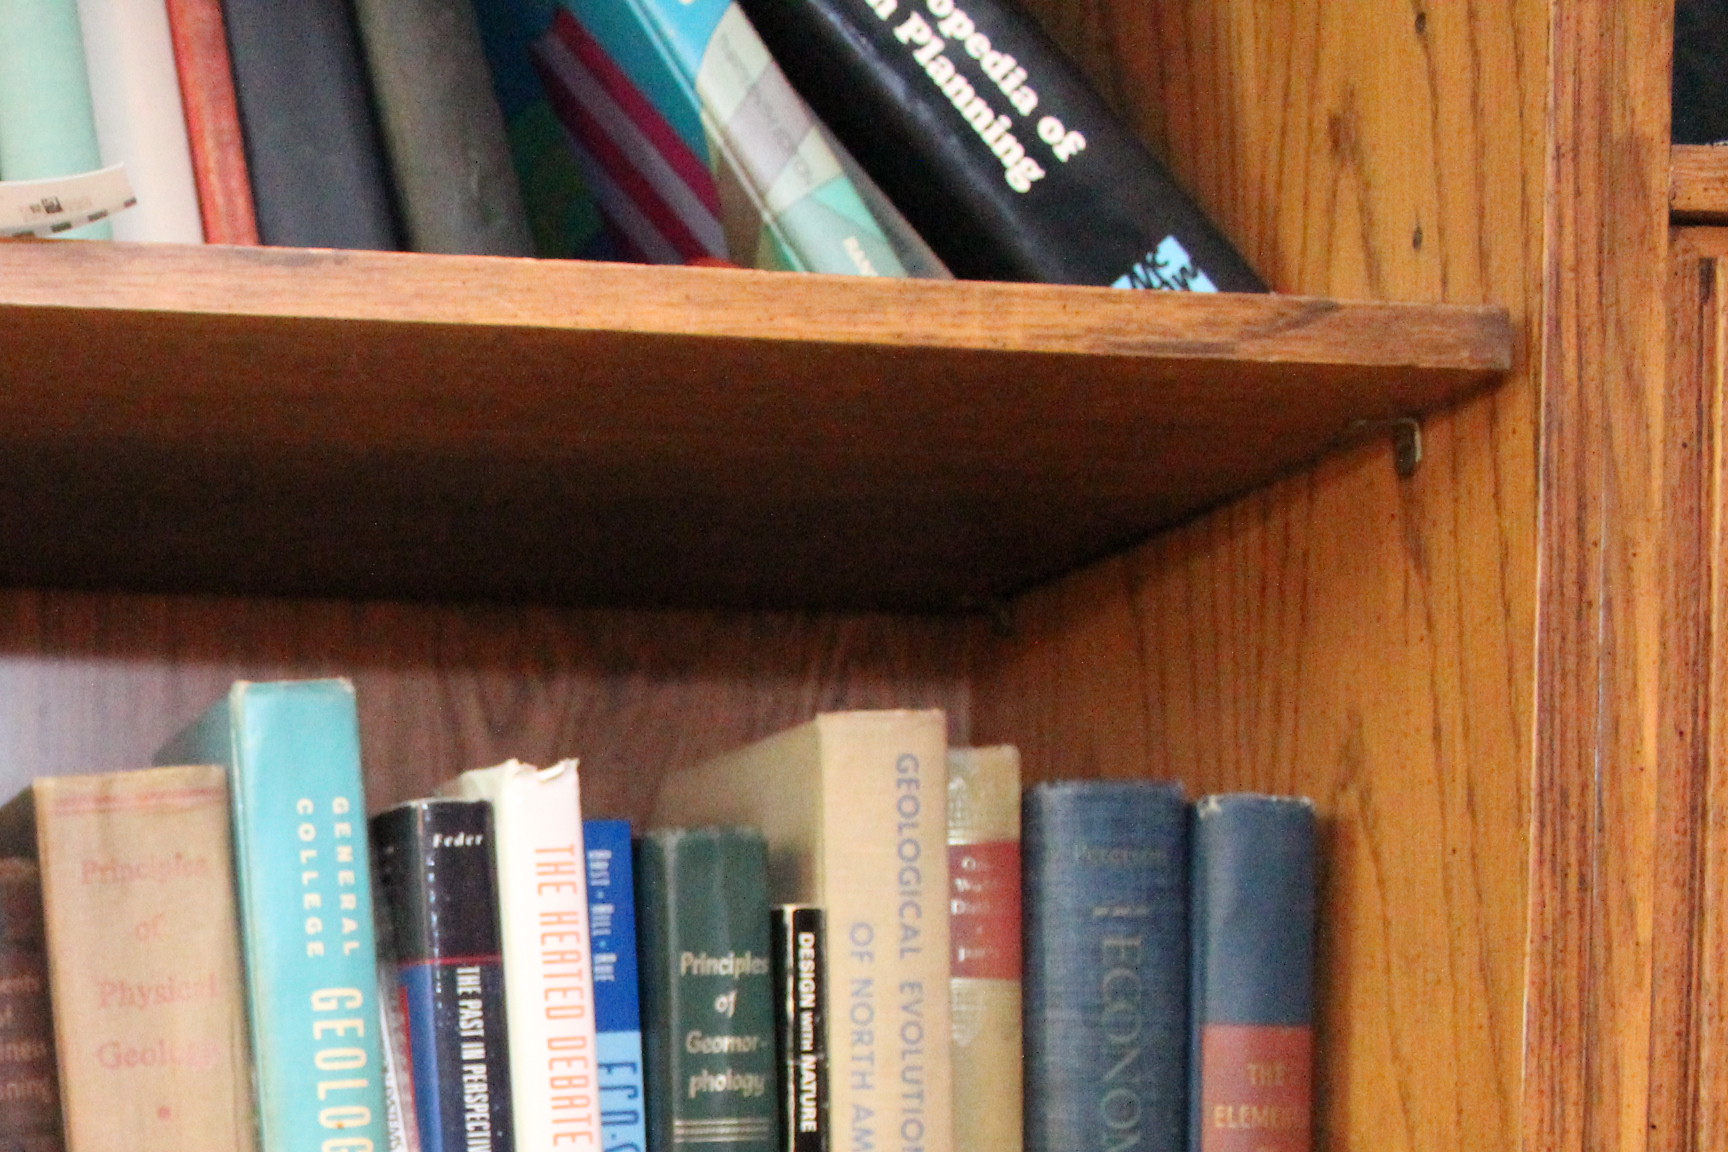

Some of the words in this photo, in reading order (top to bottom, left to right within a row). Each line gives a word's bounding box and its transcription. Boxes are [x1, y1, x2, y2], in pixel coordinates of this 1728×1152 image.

[893, 11, 1046, 193] Planning
[1037, 115, 1087, 163] of
[432, 831, 483, 848] Feder
[895, 752, 923, 960] GEOLOGICAL
[296, 797, 325, 958] COLLEGE
[332, 796, 361, 957] GENERAL
[534, 843, 578, 896] THE
[539, 911, 586, 1020] HEATED
[679, 950, 770, 980] Principles
[849, 921, 876, 963] OF
[456, 966, 482, 996] THE
[798, 932, 816, 1007] DESIGN
[458, 999, 485, 1038] PAST
[713, 990, 738, 1018] of
[461, 1042, 486, 1061] IN
[685, 1029, 768, 1054] Geomor-
[799, 1010, 814, 1051] WITH
[850, 978, 876, 1090] NORTH
[546, 1036, 593, 1147] DEBATE
[687, 1068, 766, 1099] phology
[799, 1054, 818, 1132] NATURE
